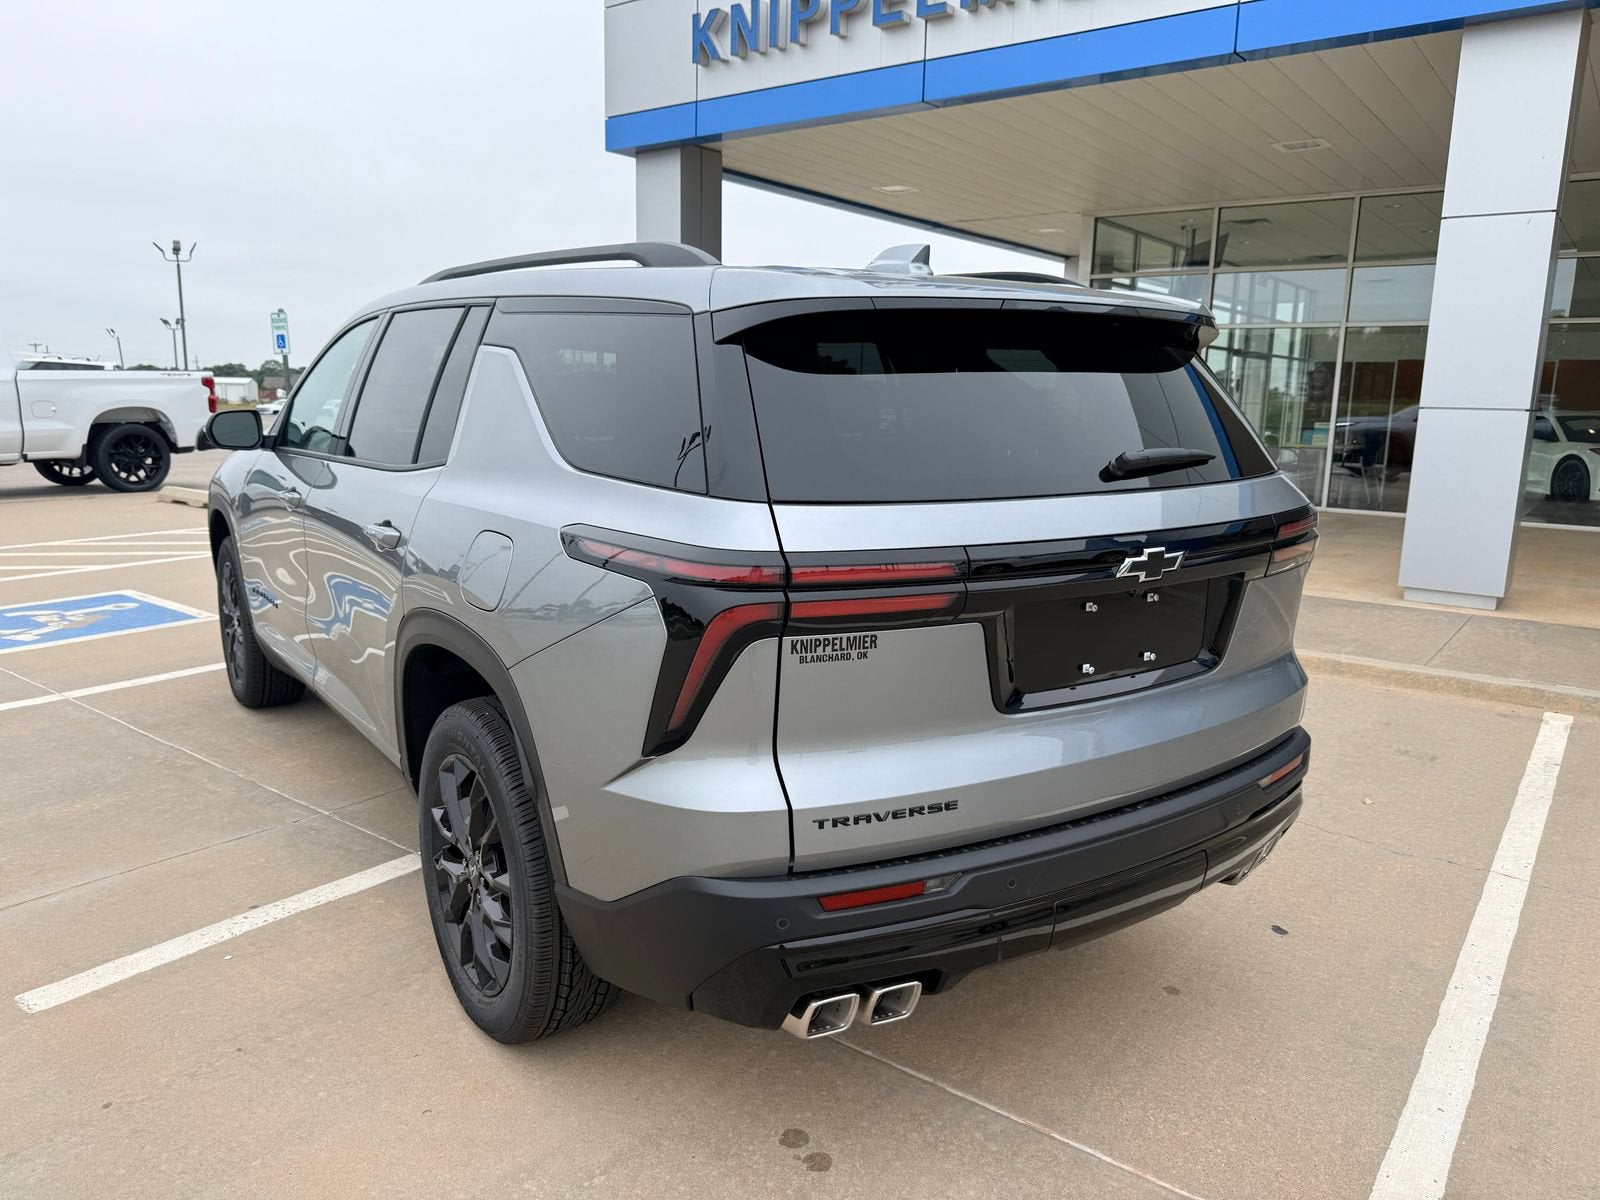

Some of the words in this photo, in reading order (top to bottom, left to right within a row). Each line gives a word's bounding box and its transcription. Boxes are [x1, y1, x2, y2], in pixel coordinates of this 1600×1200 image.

[790, 634, 878, 655] KNIPPELMIER
[799, 652, 855, 665] BLANCHARD,
[857, 651, 869, 660] OK
[812, 800, 959, 830] TRAVERSE
